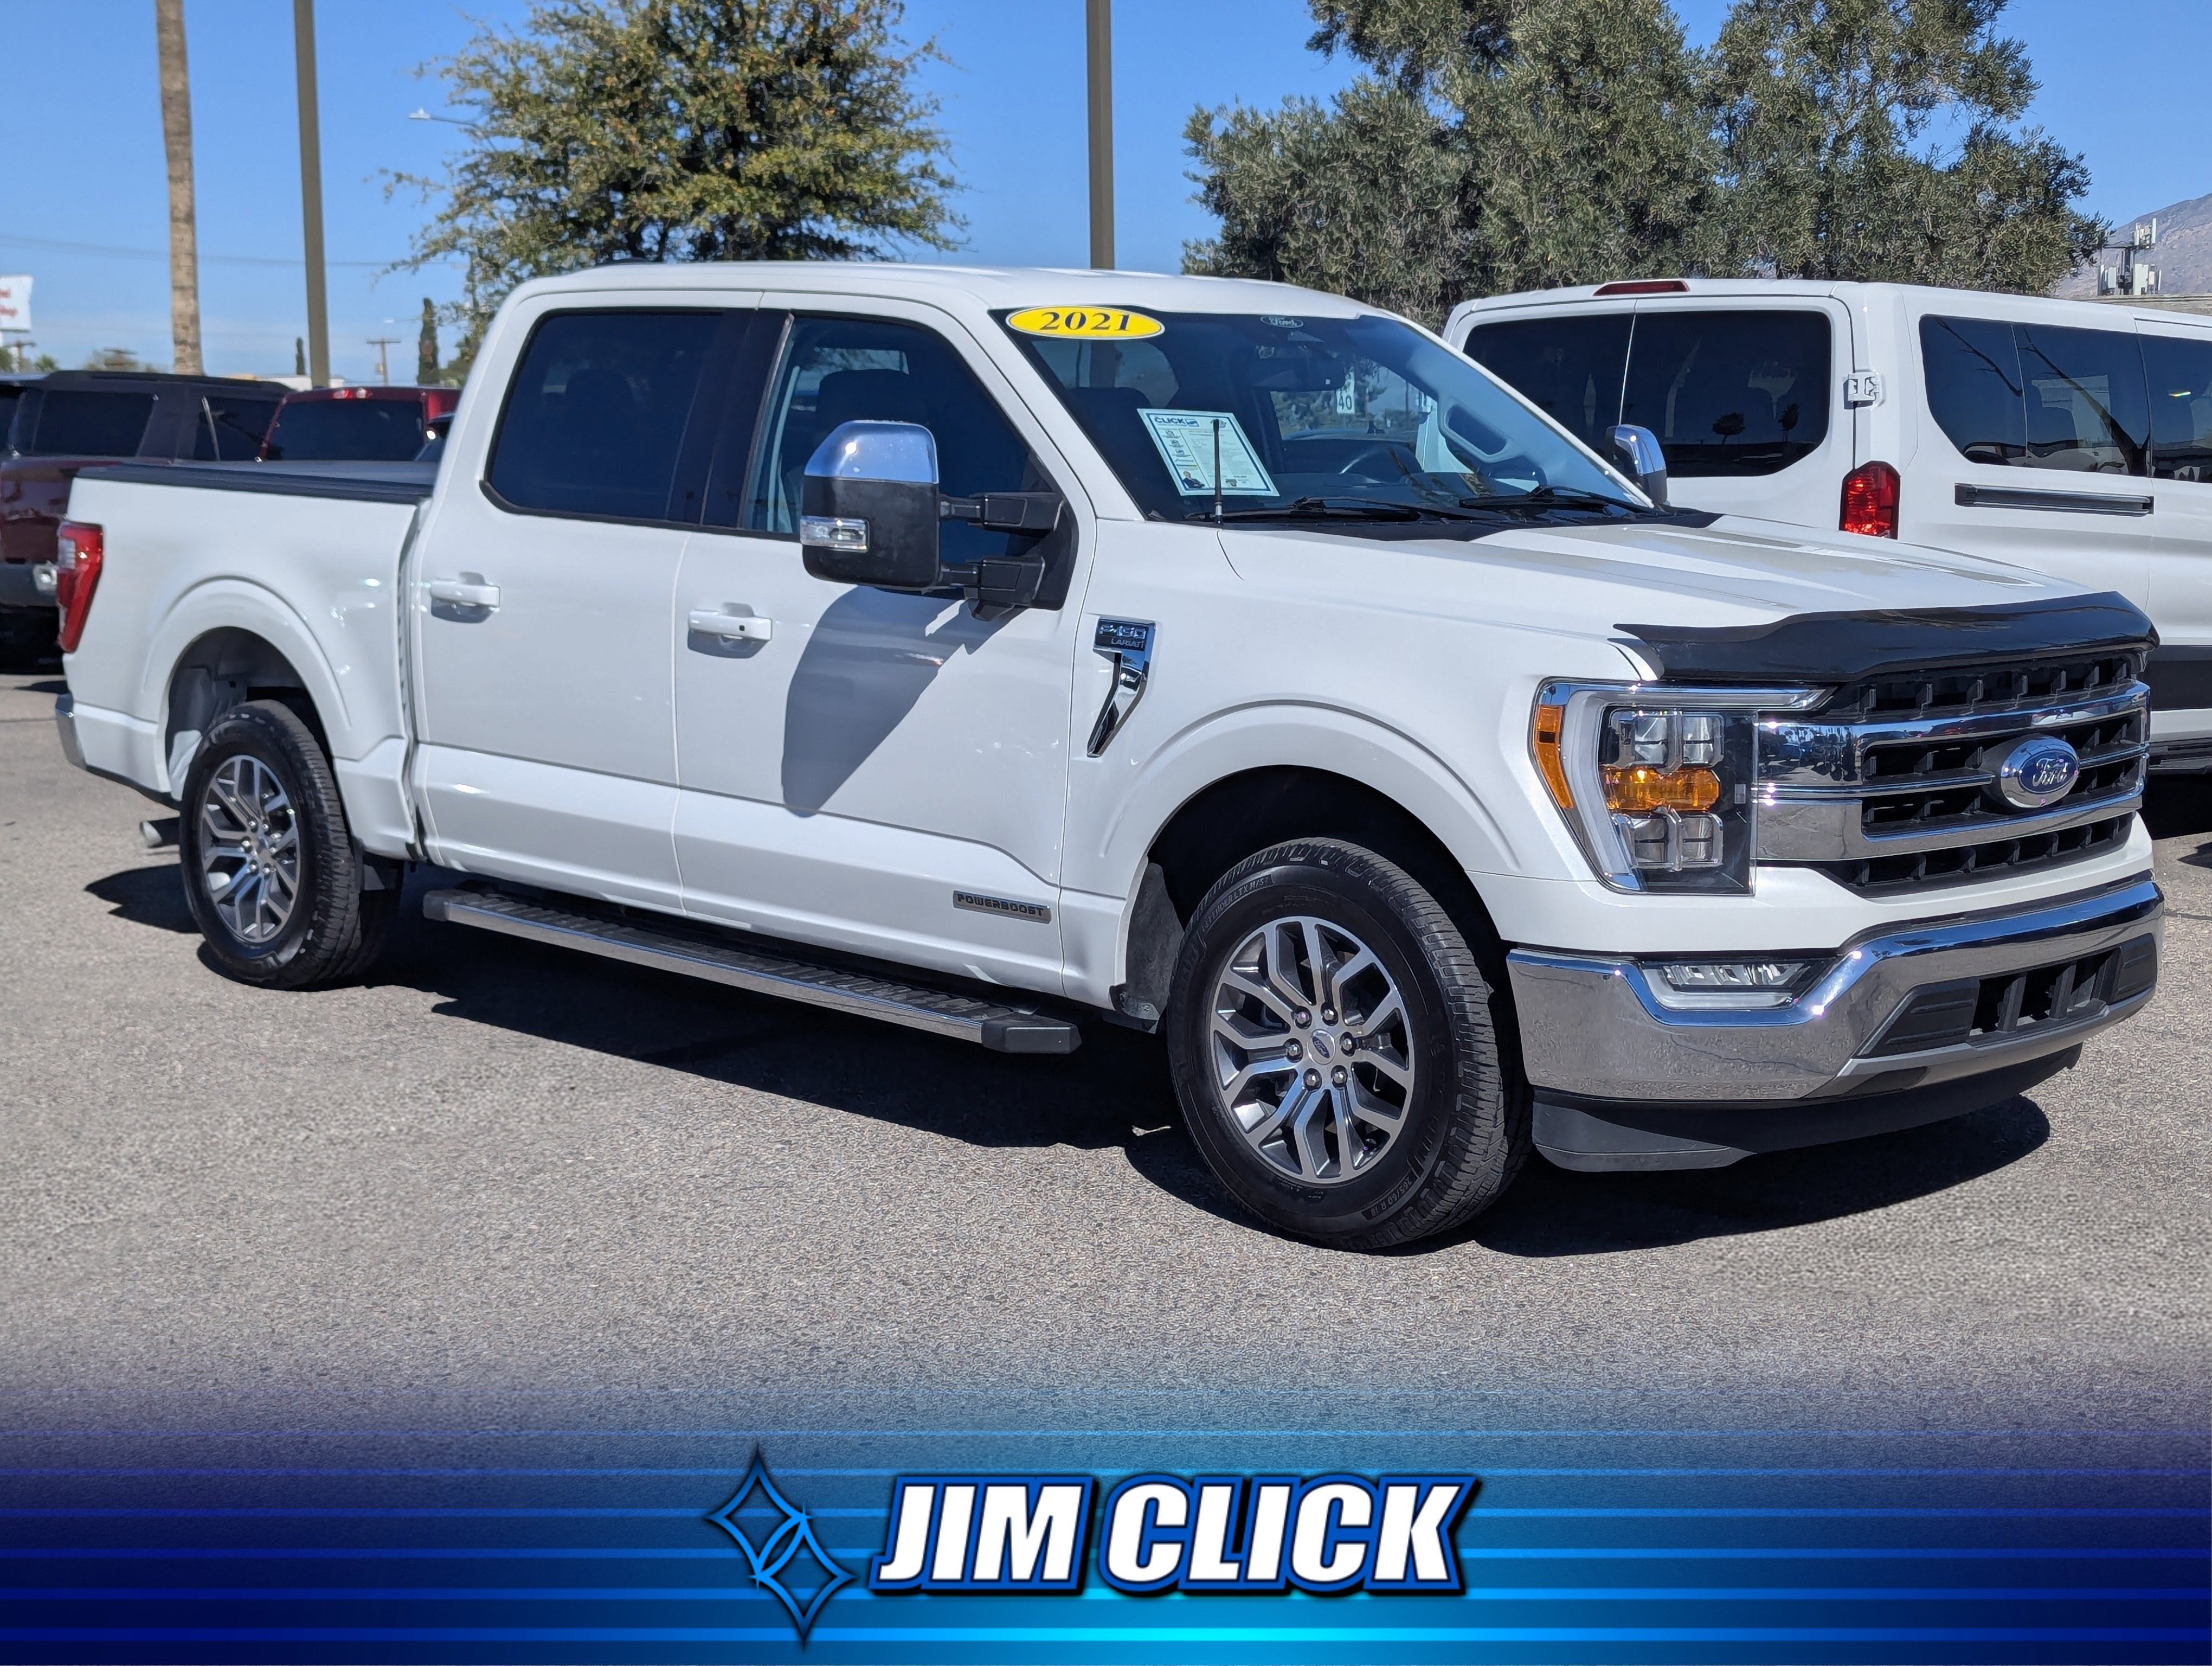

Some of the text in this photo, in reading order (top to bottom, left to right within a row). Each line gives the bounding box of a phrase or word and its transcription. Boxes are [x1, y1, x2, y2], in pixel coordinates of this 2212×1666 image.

[1039, 311, 1131, 332] 2021
[1339, 395, 1352, 411] 40
[1110, 638, 1144, 649] LARIAT
[2032, 757, 2070, 787] Ford
[956, 893, 1044, 917] POWERBOOST
